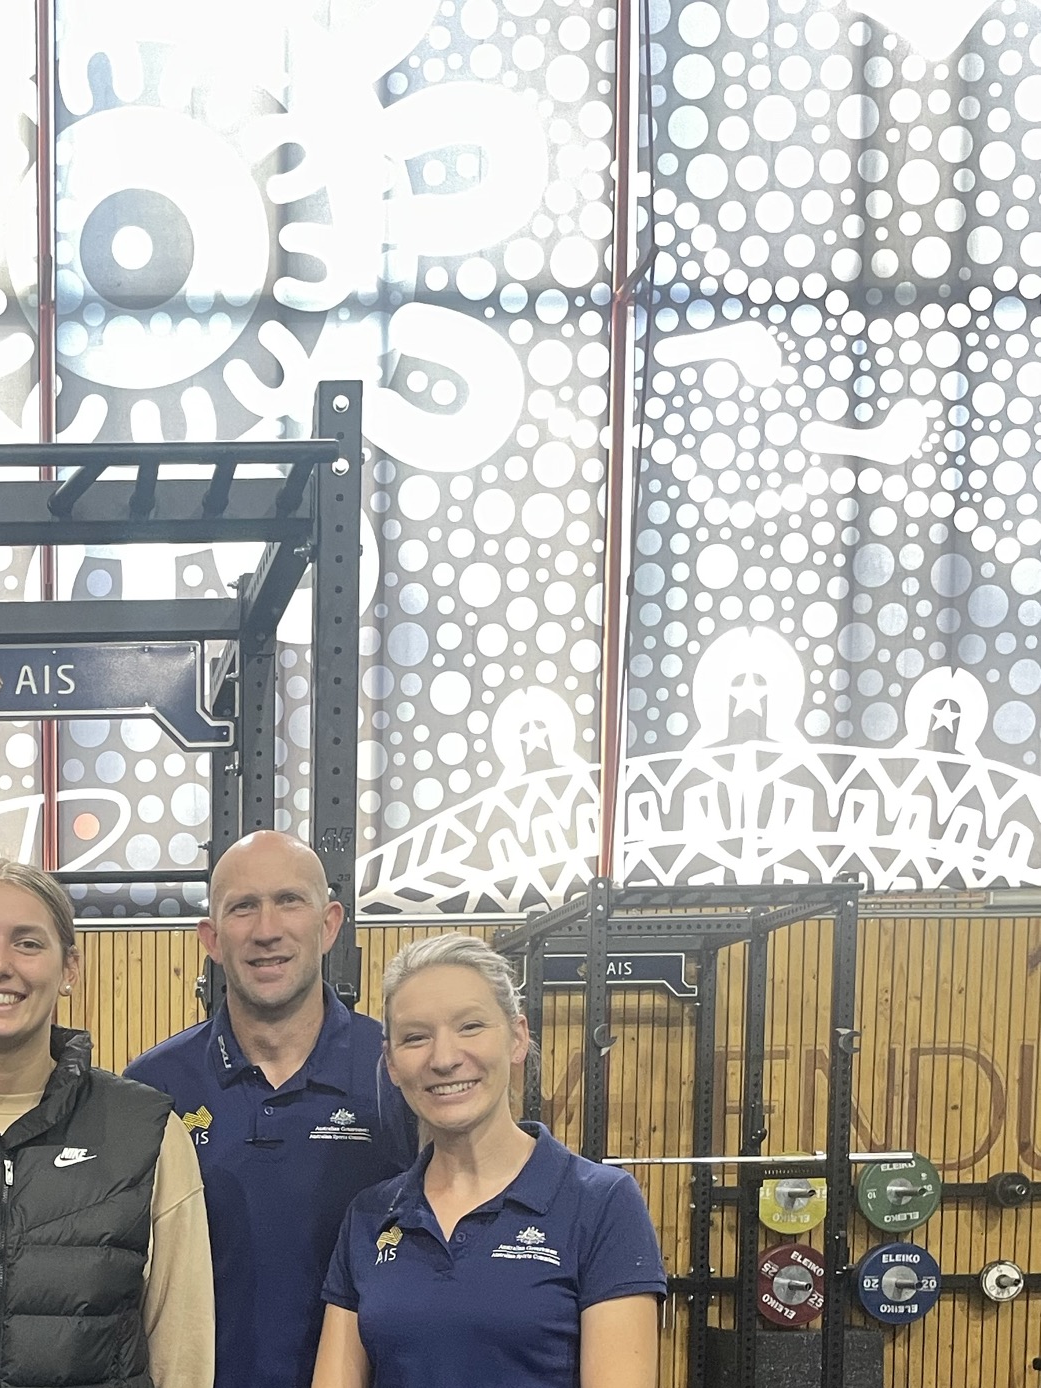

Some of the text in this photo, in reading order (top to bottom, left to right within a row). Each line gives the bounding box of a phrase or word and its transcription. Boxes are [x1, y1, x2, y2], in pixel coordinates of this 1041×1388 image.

[15, 664, 76, 695] AIS
[606, 961, 633, 975] AIS
[195, 1130, 209, 1145] IS
[60, 1147, 88, 1160] NIKE
[375, 1247, 397, 1266] AIS
[790, 1250, 825, 1278] ELEIKO
[881, 1253, 921, 1264] ELEIKO
[762, 1293, 797, 1320] ELEIKO
